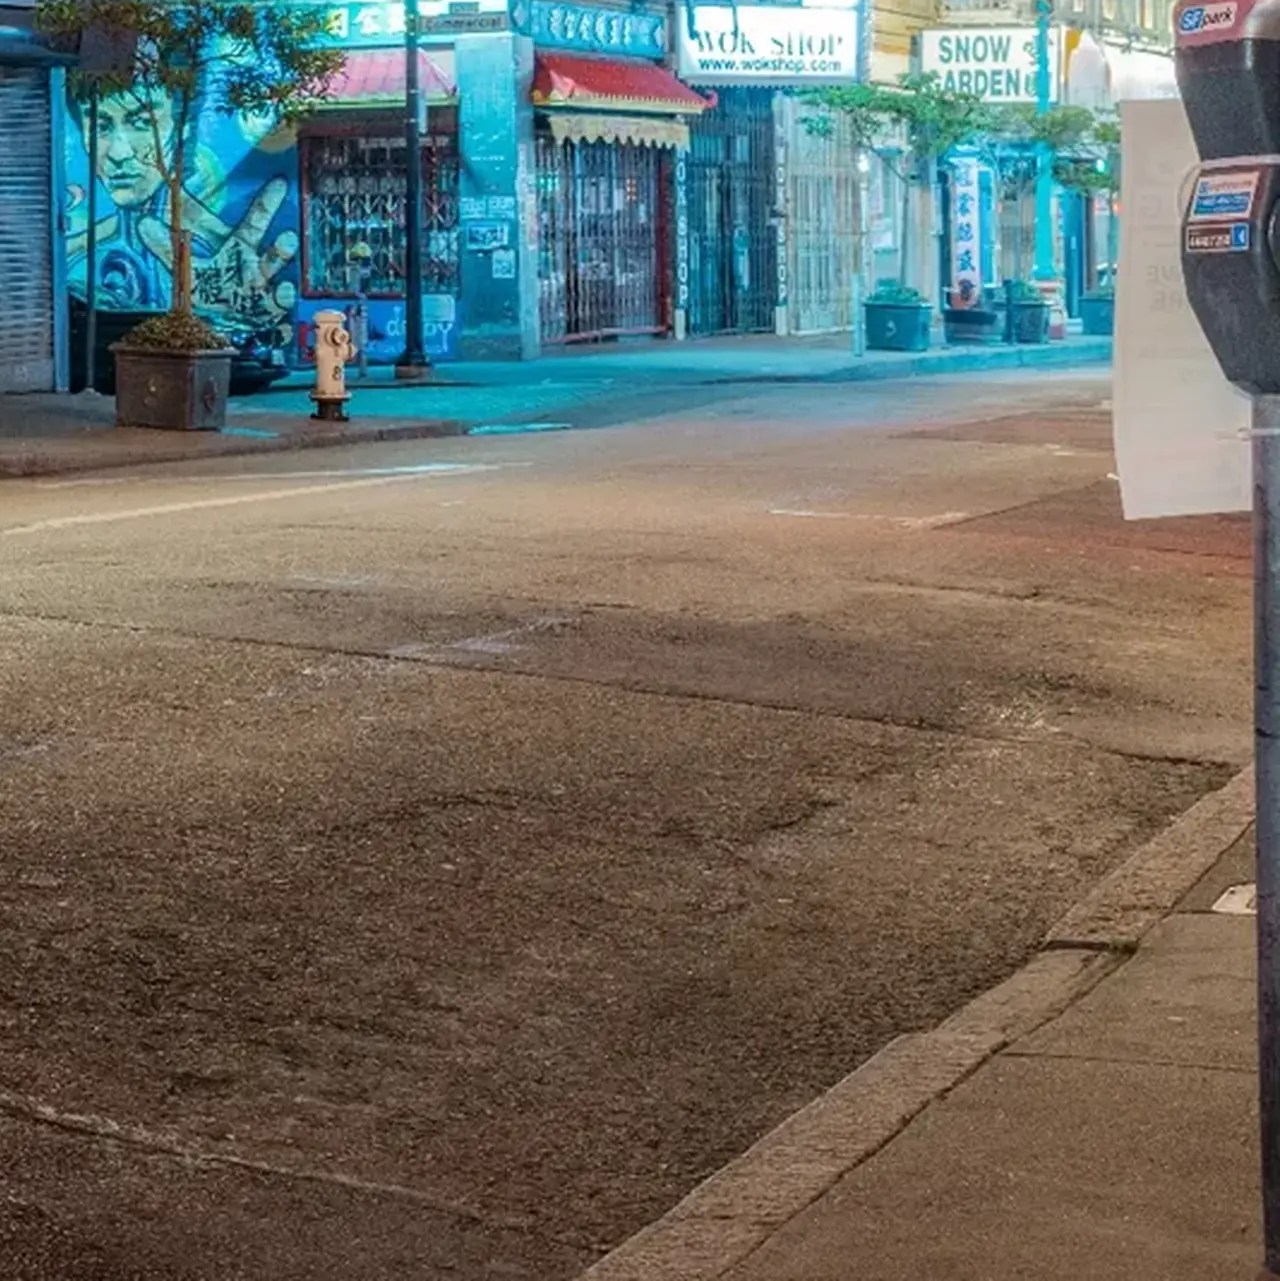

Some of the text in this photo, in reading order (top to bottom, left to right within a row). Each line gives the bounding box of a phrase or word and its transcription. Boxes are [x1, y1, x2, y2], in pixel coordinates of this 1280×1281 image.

[693, 29, 843, 56] WOK SHOP
[939, 35, 1011, 64] SNOW
[698, 56, 842, 73] www.wokshop.com
[940, 69, 1021, 97] ARDEN
